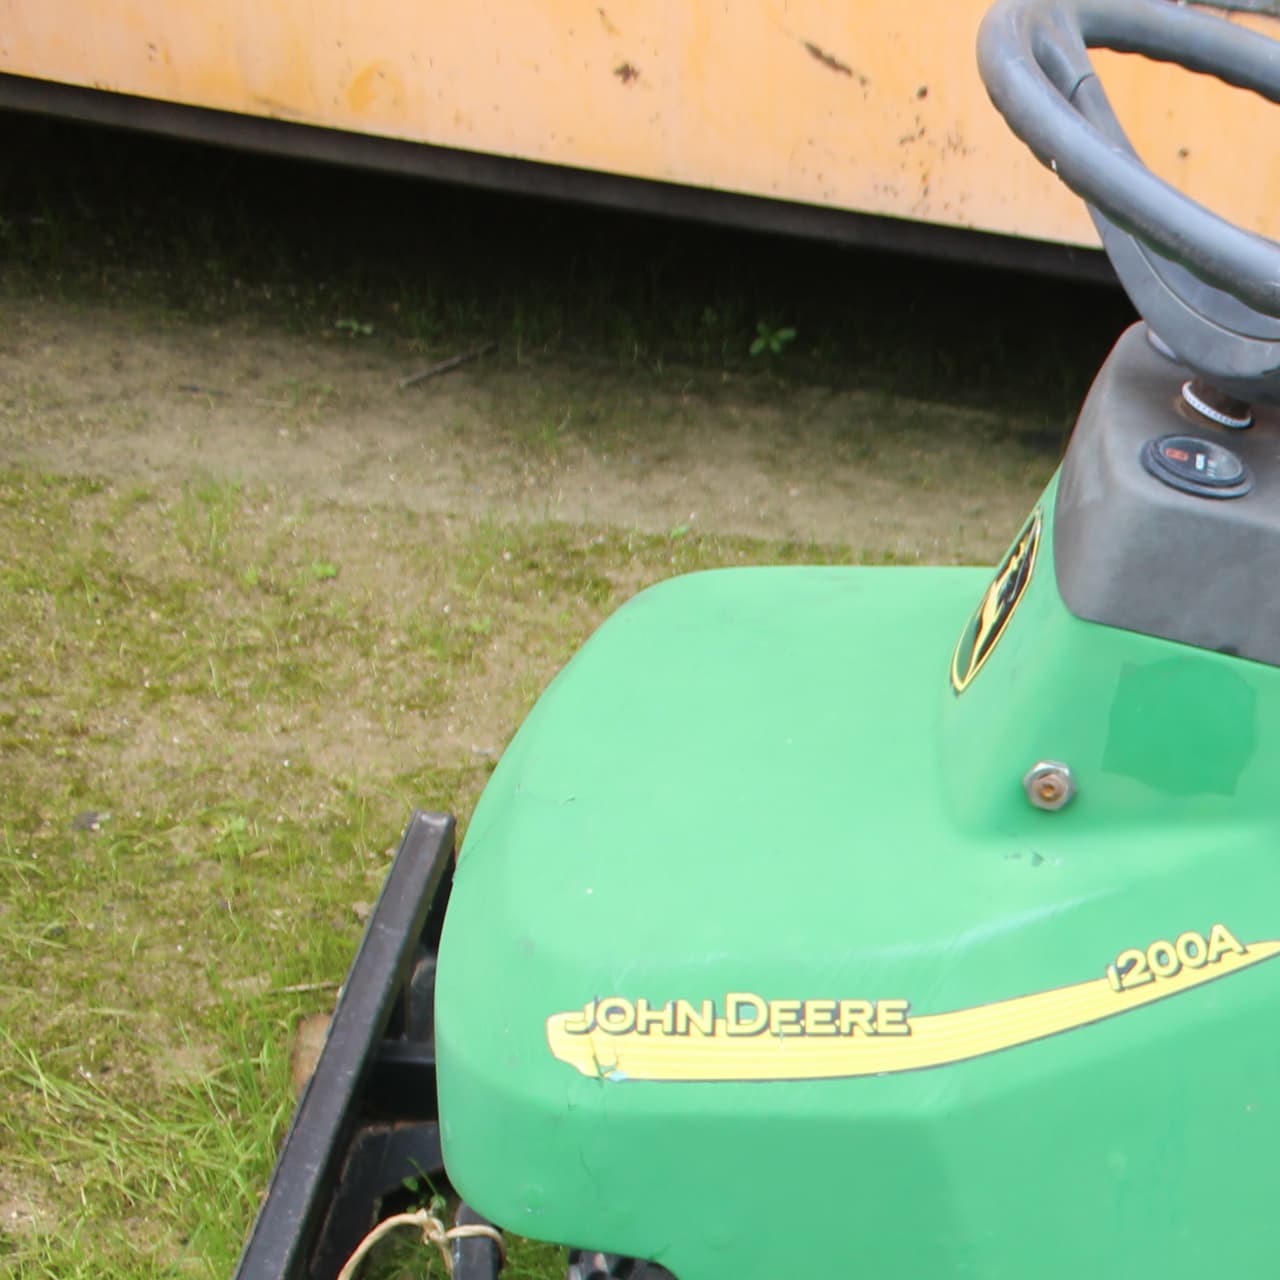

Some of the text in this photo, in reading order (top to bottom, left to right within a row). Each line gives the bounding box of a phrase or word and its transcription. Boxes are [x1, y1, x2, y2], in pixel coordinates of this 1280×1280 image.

[1107, 922, 1249, 993] 1200A
[563, 991, 912, 1037] JOHN DEERE
